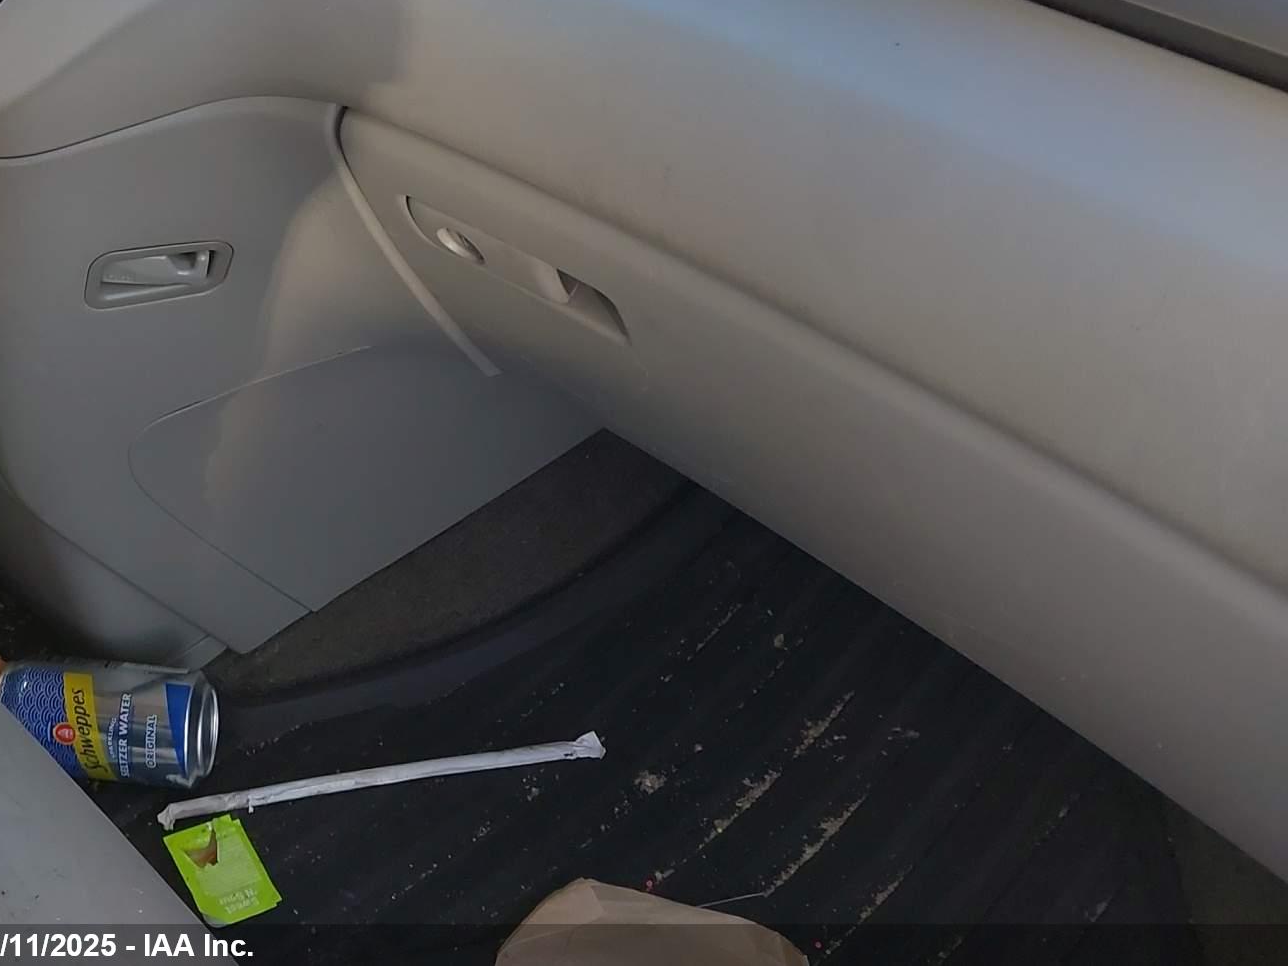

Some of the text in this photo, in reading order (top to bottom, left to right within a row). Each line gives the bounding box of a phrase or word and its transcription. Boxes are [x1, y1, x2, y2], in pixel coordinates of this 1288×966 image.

[75, 687, 109, 774] Schweppes
[118, 693, 132, 779] SELTZER WATER
[145, 713, 158, 769] ORIGINAL
